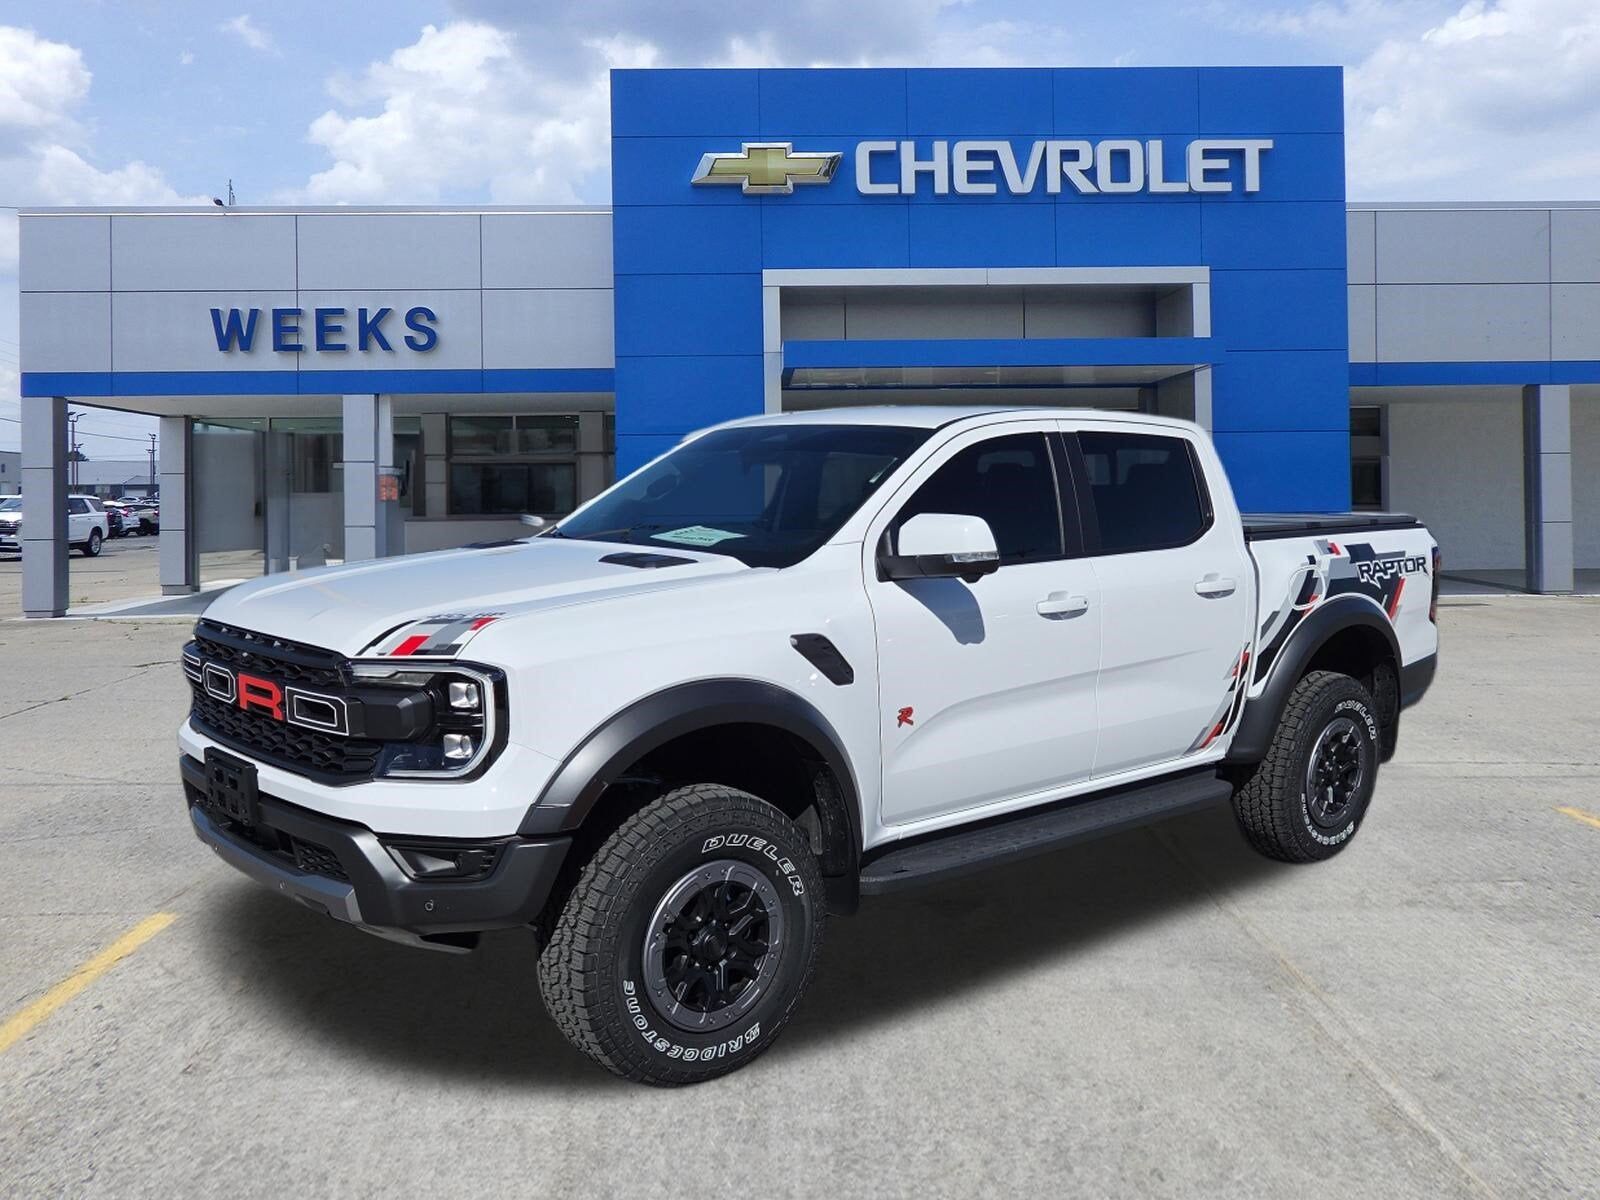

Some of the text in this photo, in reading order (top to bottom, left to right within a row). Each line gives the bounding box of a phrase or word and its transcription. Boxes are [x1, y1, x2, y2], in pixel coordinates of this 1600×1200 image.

[855, 139, 1274, 194] CHEVROLET
[210, 306, 437, 352] WEEKS
[1356, 556, 1429, 589] RAPTOR
[702, 833, 804, 896] DUELER
[623, 980, 761, 1061] BRIDGESTONE
